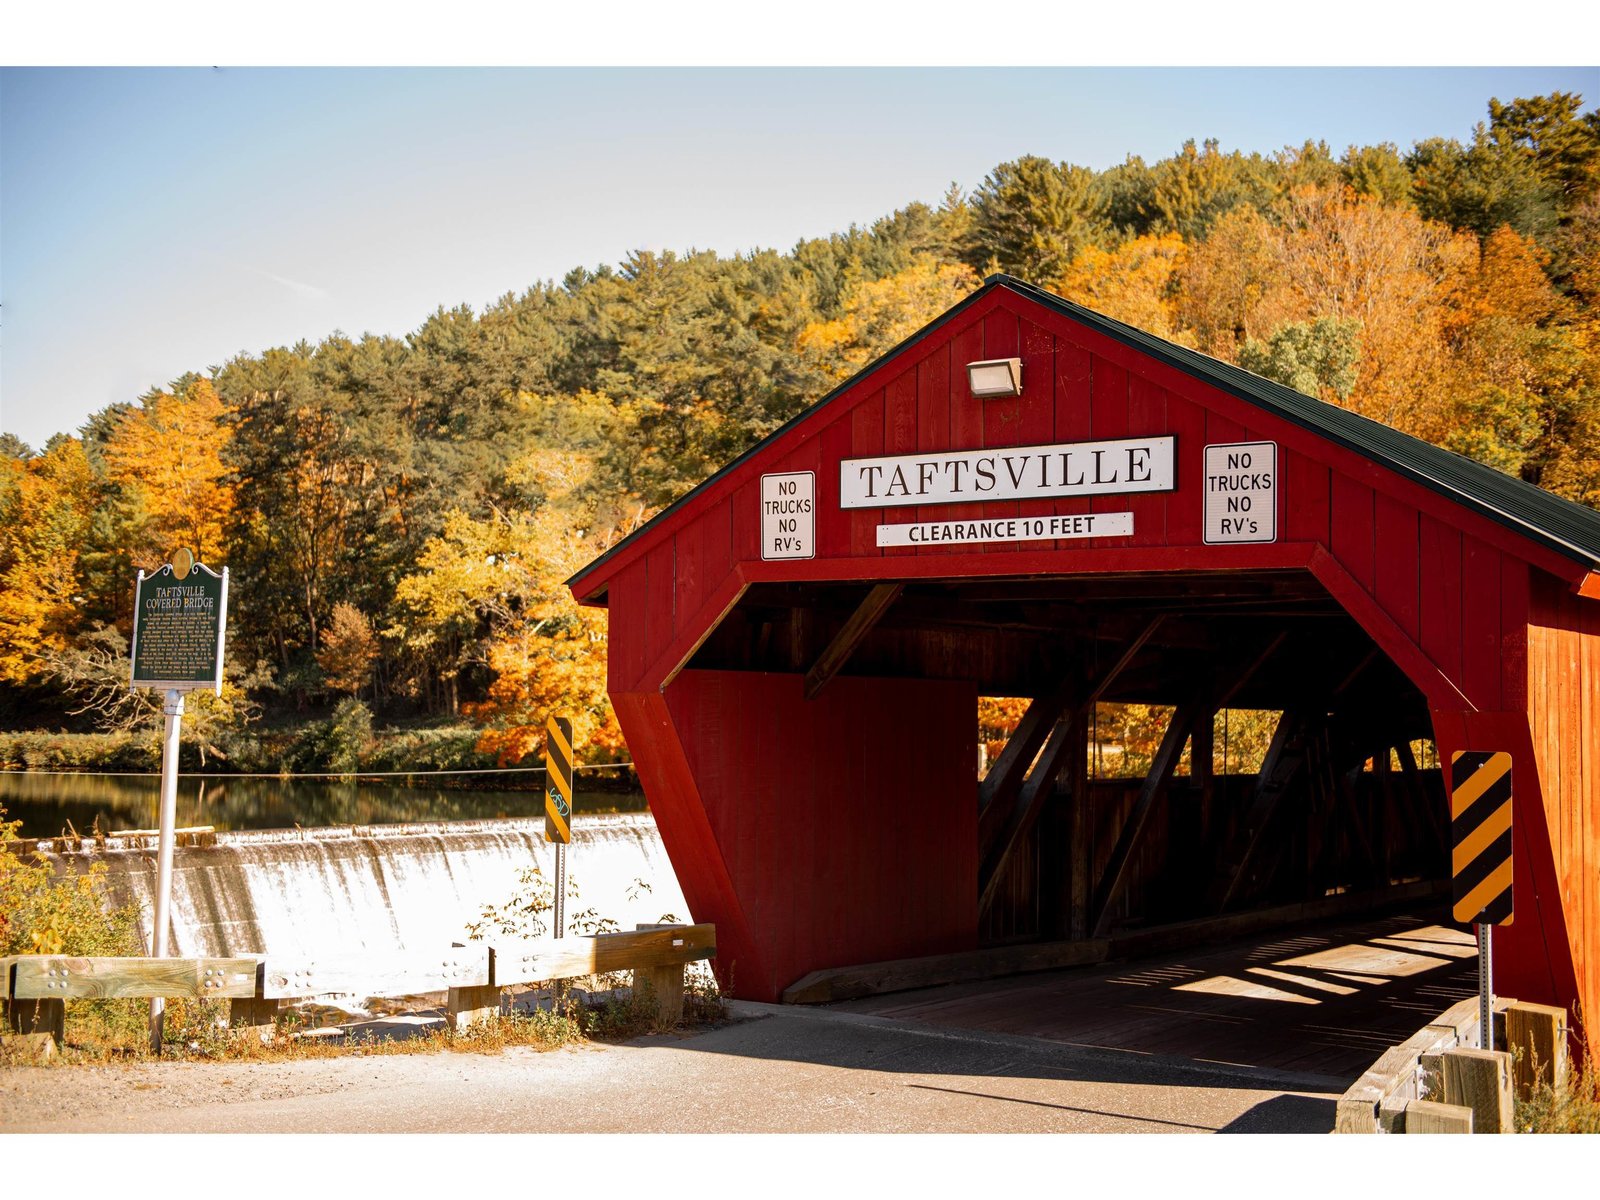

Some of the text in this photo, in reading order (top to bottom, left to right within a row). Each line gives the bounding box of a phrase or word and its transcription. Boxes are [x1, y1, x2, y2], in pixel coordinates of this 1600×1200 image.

[1227, 452, 1252, 470] NO
[859, 447, 1152, 498] TAFTSVILLE
[779, 481, 797, 496] NO
[1208, 473, 1272, 492] TRUCKS
[764, 498, 811, 515] TRUCKS
[1227, 495, 1252, 513] NO
[779, 518, 797, 533] NO
[908, 516, 1095, 542] CLEARANCE 10 FEET
[1221, 517, 1258, 535] RV's
[774, 537, 802, 552] RV's
[156, 586, 205, 597] TAFTSVILLE
[146, 597, 214, 609] COVERED BRIDGE
